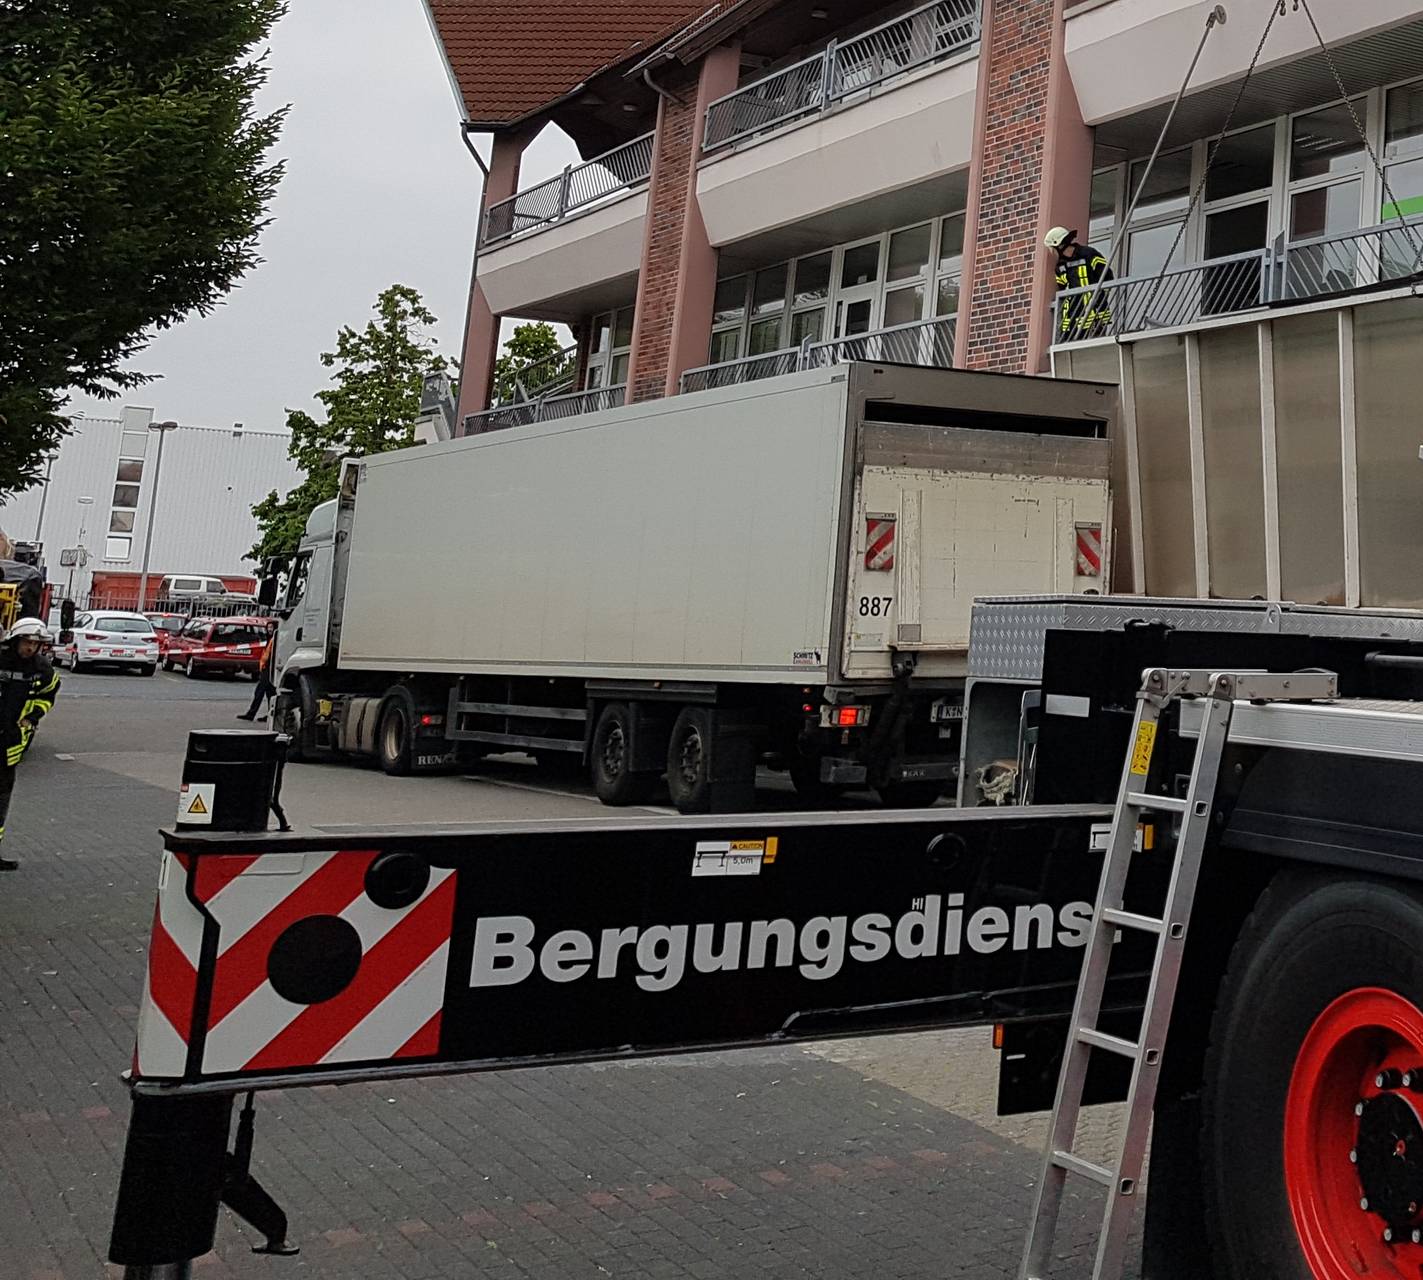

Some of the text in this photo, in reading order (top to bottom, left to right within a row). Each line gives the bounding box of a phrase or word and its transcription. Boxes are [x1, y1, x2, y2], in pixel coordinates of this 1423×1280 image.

[859, 596, 892, 617] 887
[738, 842, 763, 850] CAUTION
[469, 893, 1125, 992] Bergungsdiens
